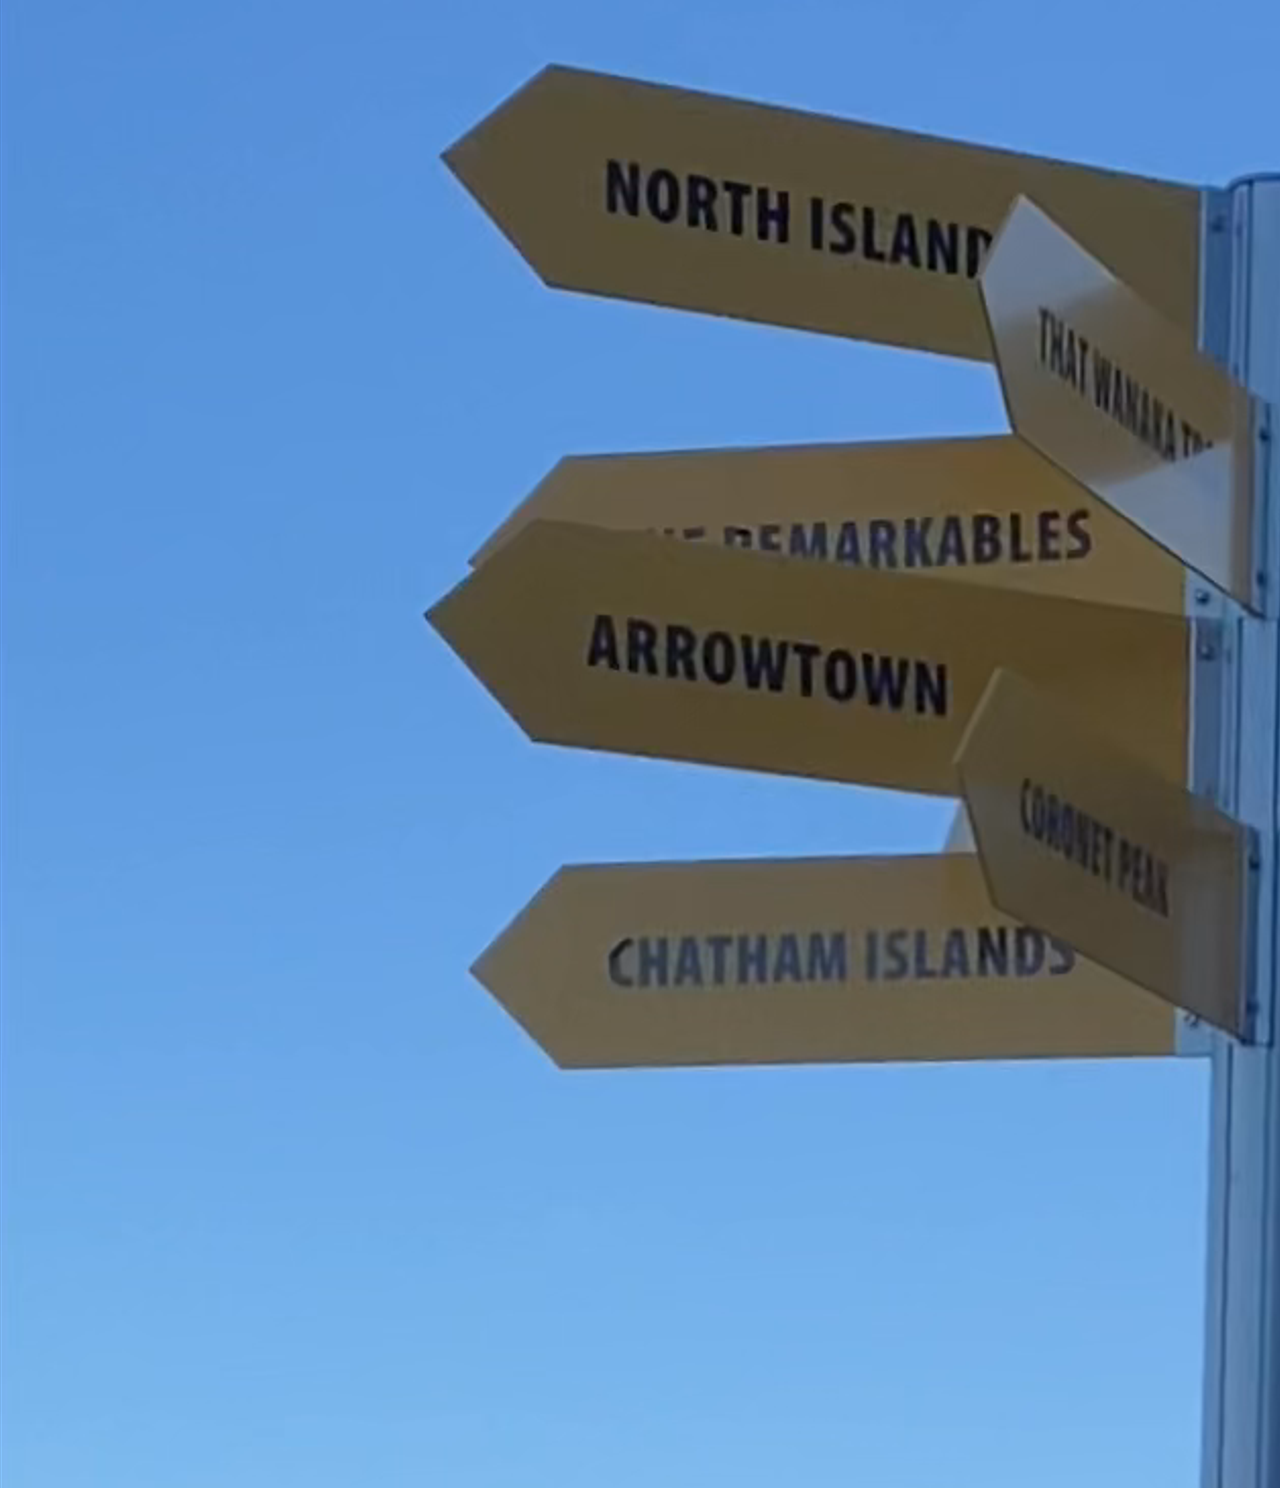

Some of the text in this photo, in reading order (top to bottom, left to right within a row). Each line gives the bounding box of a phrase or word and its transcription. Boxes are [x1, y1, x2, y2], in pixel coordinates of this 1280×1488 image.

[605, 157, 790, 244] NORTH
[1039, 307, 1088, 396] THAT
[1094, 348, 1176, 463] WANAKA
[587, 614, 948, 716] ARROWTOWN
[1020, 777, 1169, 918] CORONET PEAK
[608, 926, 1076, 989] CHATHAM ISLANDS
